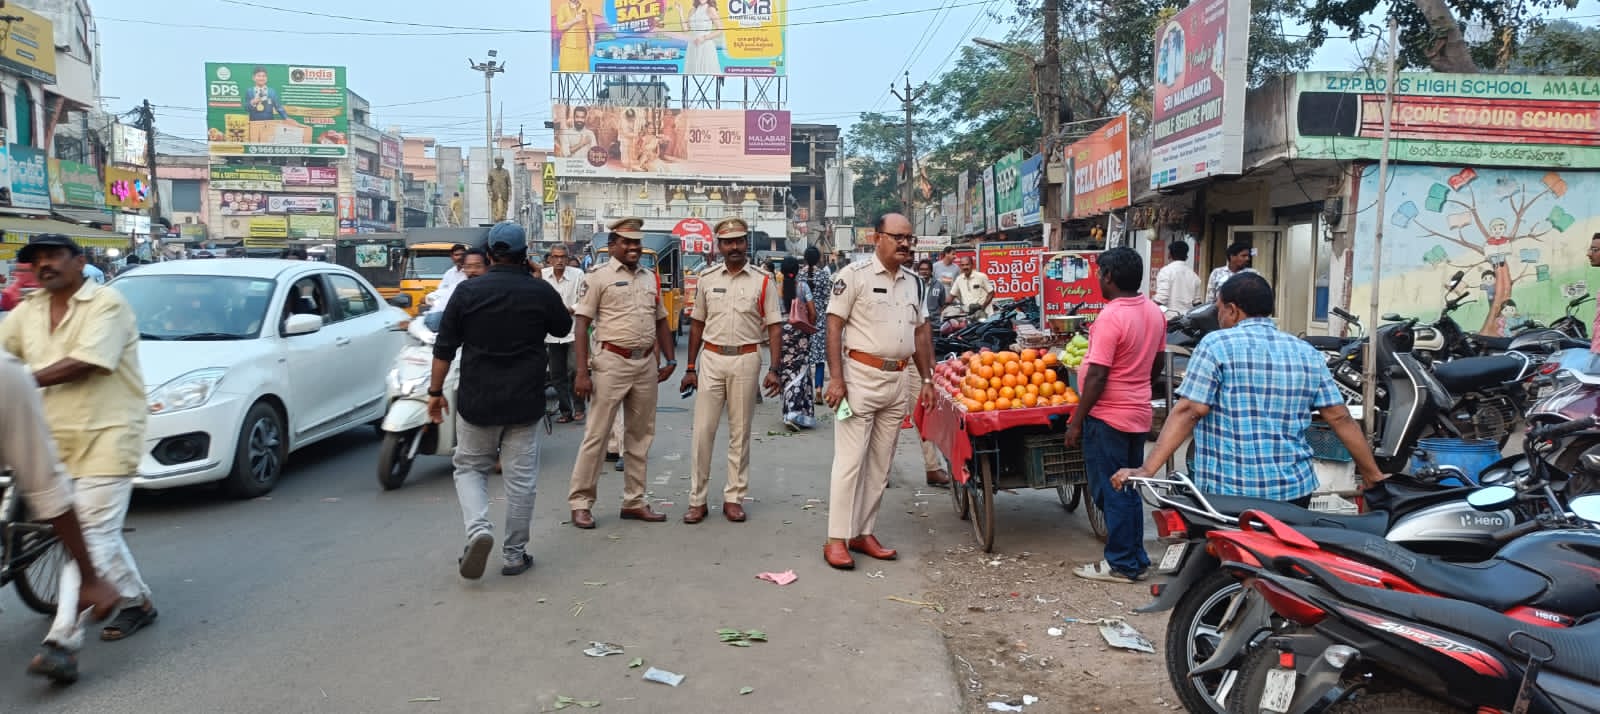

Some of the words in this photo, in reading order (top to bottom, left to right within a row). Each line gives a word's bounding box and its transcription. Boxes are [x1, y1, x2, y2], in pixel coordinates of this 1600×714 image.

[617, 2, 661, 23] SALE
[210, 84, 239, 96] DPS
[1174, 77, 1211, 107] MANIKANTA
[1417, 80, 1456, 93] HIGH
[1460, 80, 1532, 95] SCHOOL
[1176, 107, 1200, 132] SERVICE
[1201, 96, 1222, 123] POINT
[1363, 103, 1448, 123] WLCOME
[1455, 108, 1476, 124] TO
[1480, 109, 1516, 126] OUR
[1521, 111, 1595, 130] SCHOOL
[544, 163, 555, 178] A
[1074, 163, 1095, 196] CELL
[1096, 149, 1122, 188] CARE
[545, 187, 556, 203] Z
[1047, 302, 1059, 310] Sri
